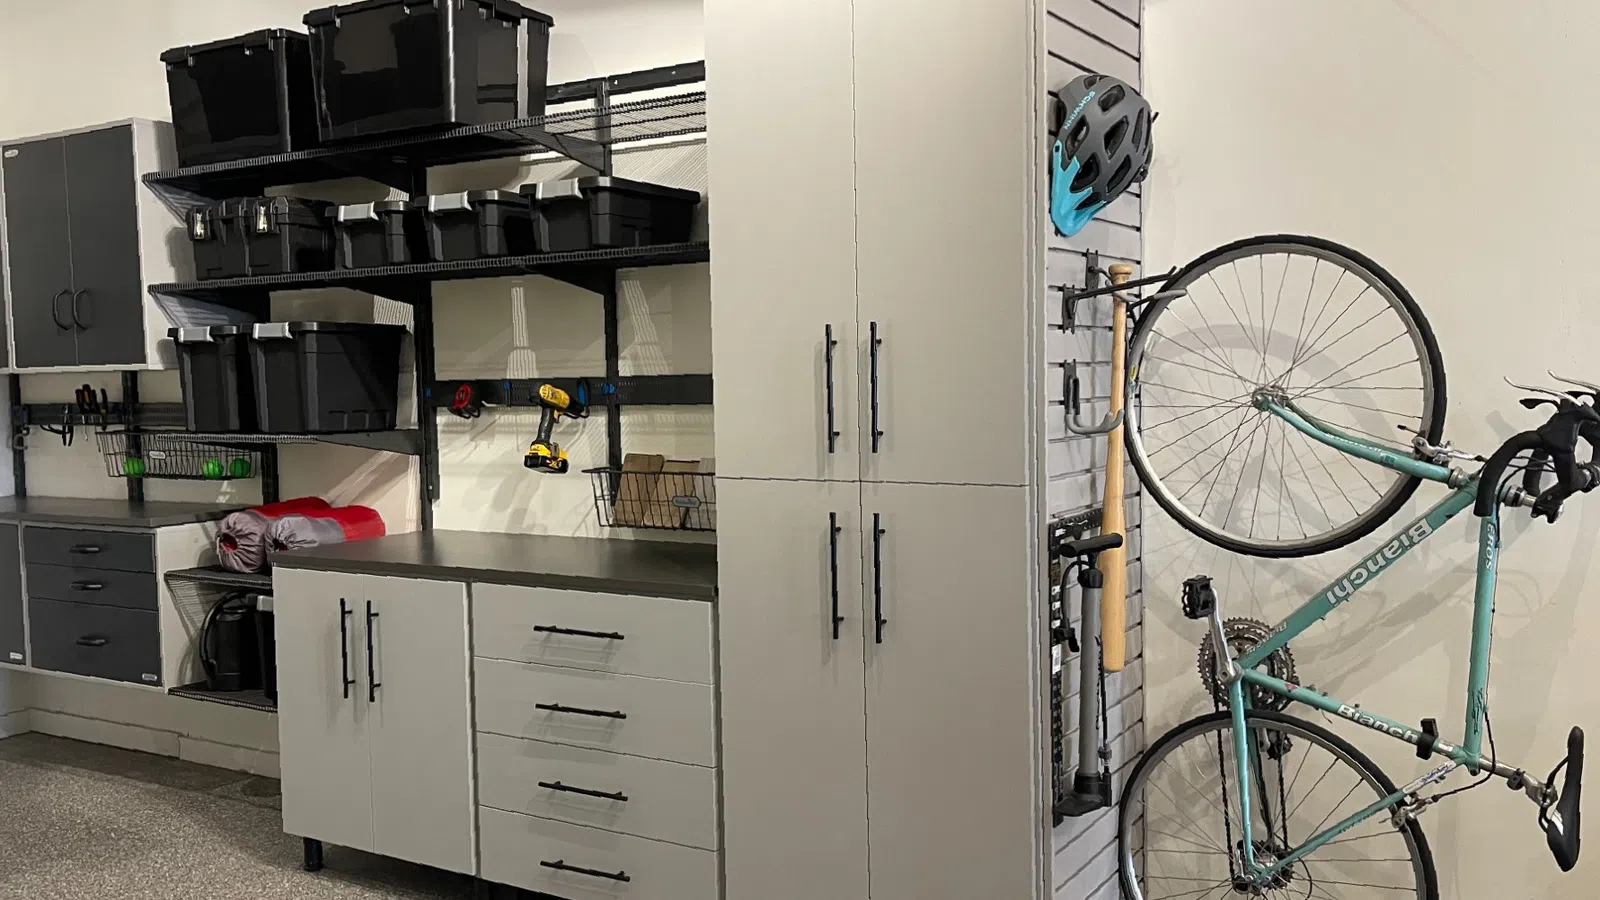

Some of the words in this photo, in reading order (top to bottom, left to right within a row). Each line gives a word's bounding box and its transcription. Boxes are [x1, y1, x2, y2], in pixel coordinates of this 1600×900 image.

[1064, 90, 1096, 130] SCHWINN
[1326, 518, 1433, 607] Bianchi
[1337, 703, 1419, 744] Bianch
